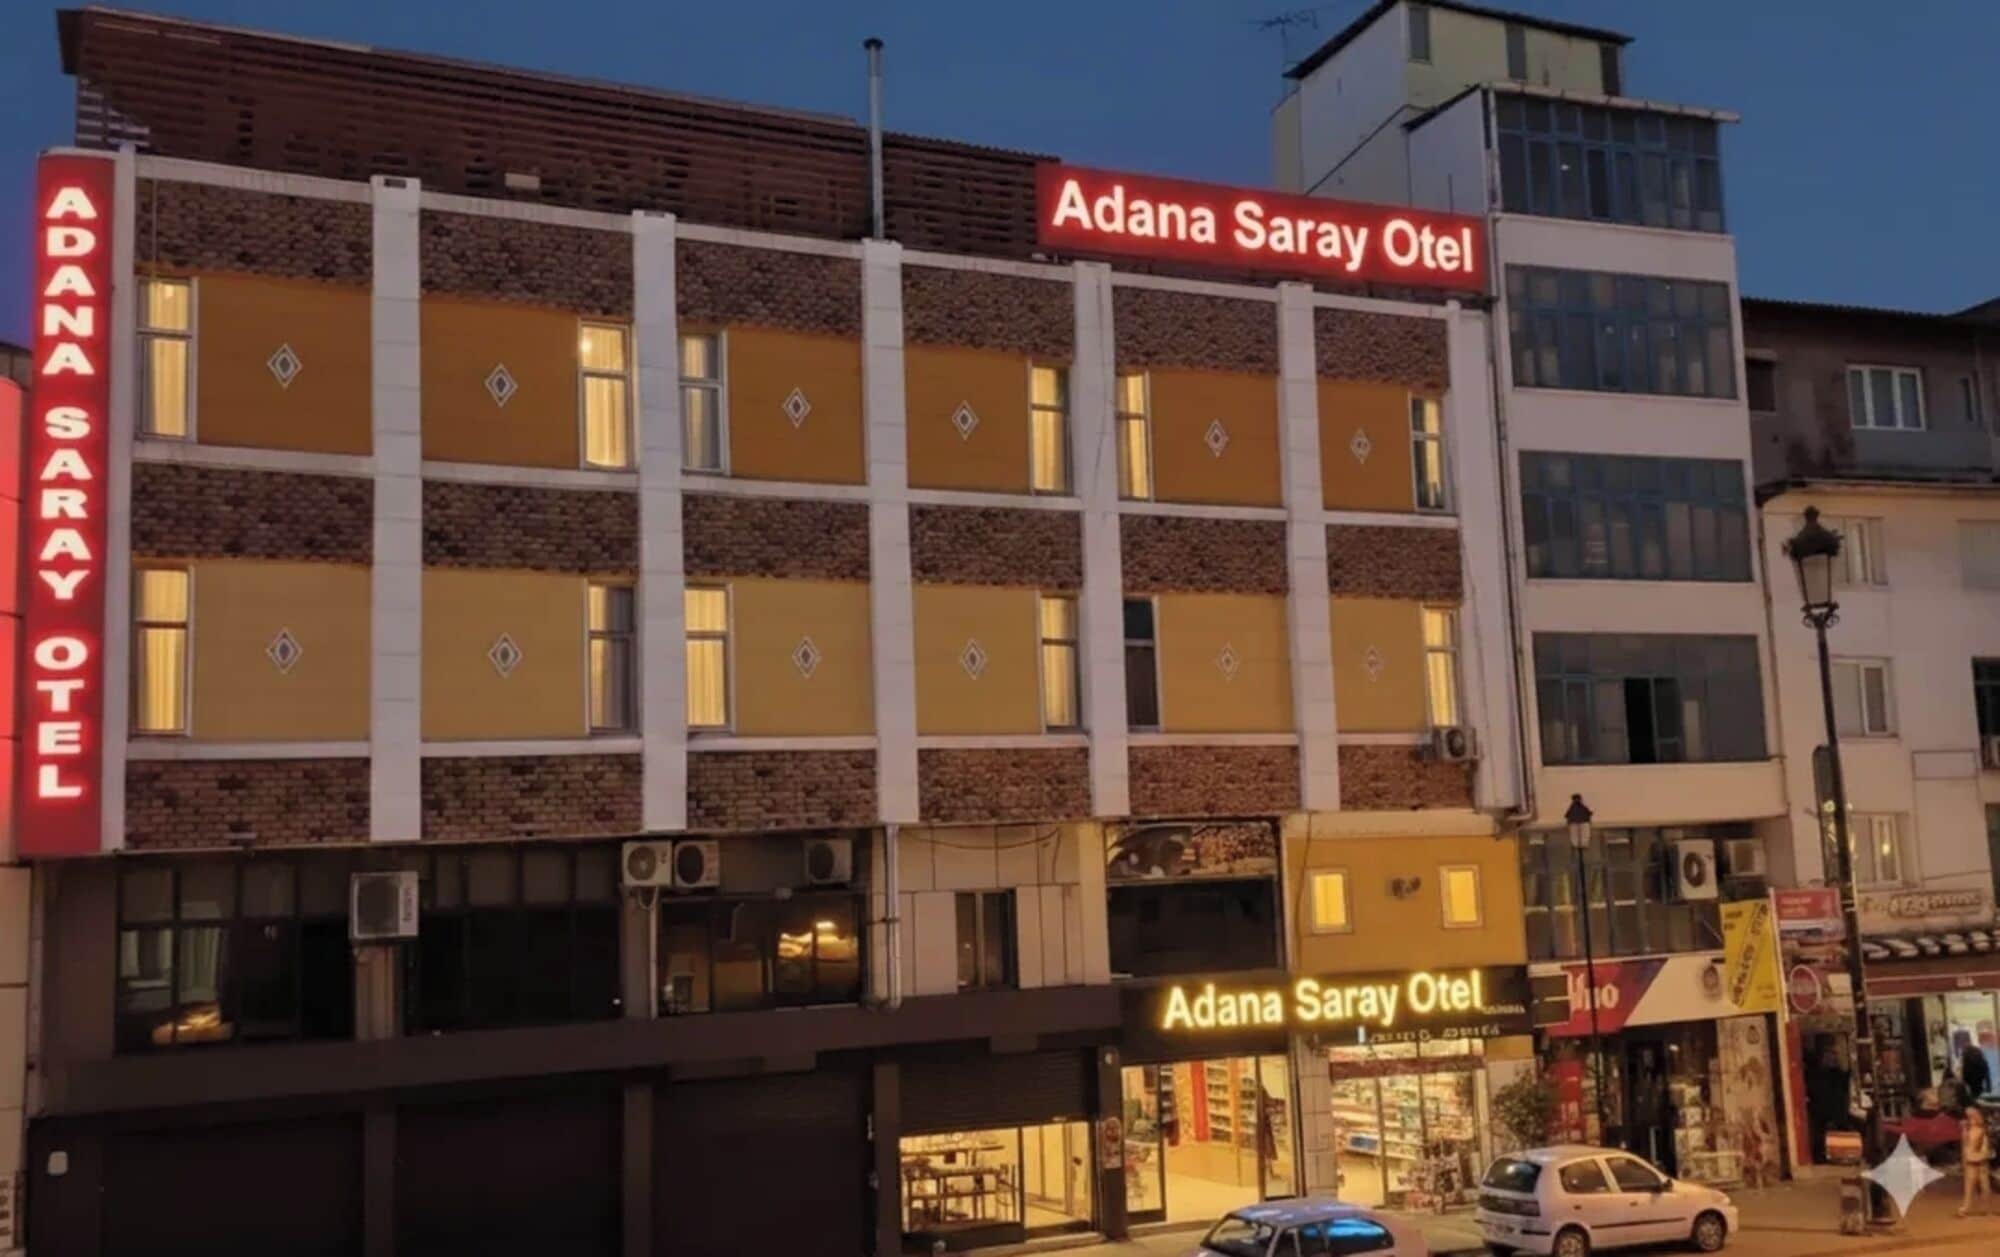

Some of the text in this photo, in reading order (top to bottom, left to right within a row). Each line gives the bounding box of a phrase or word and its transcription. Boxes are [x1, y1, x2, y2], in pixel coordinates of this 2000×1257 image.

[1053, 179, 1473, 272] Adana Saray Otel
[35, 187, 98, 798] ADANA SARAY OTEL
[1163, 969, 1482, 1029] Adana Saray Otel
